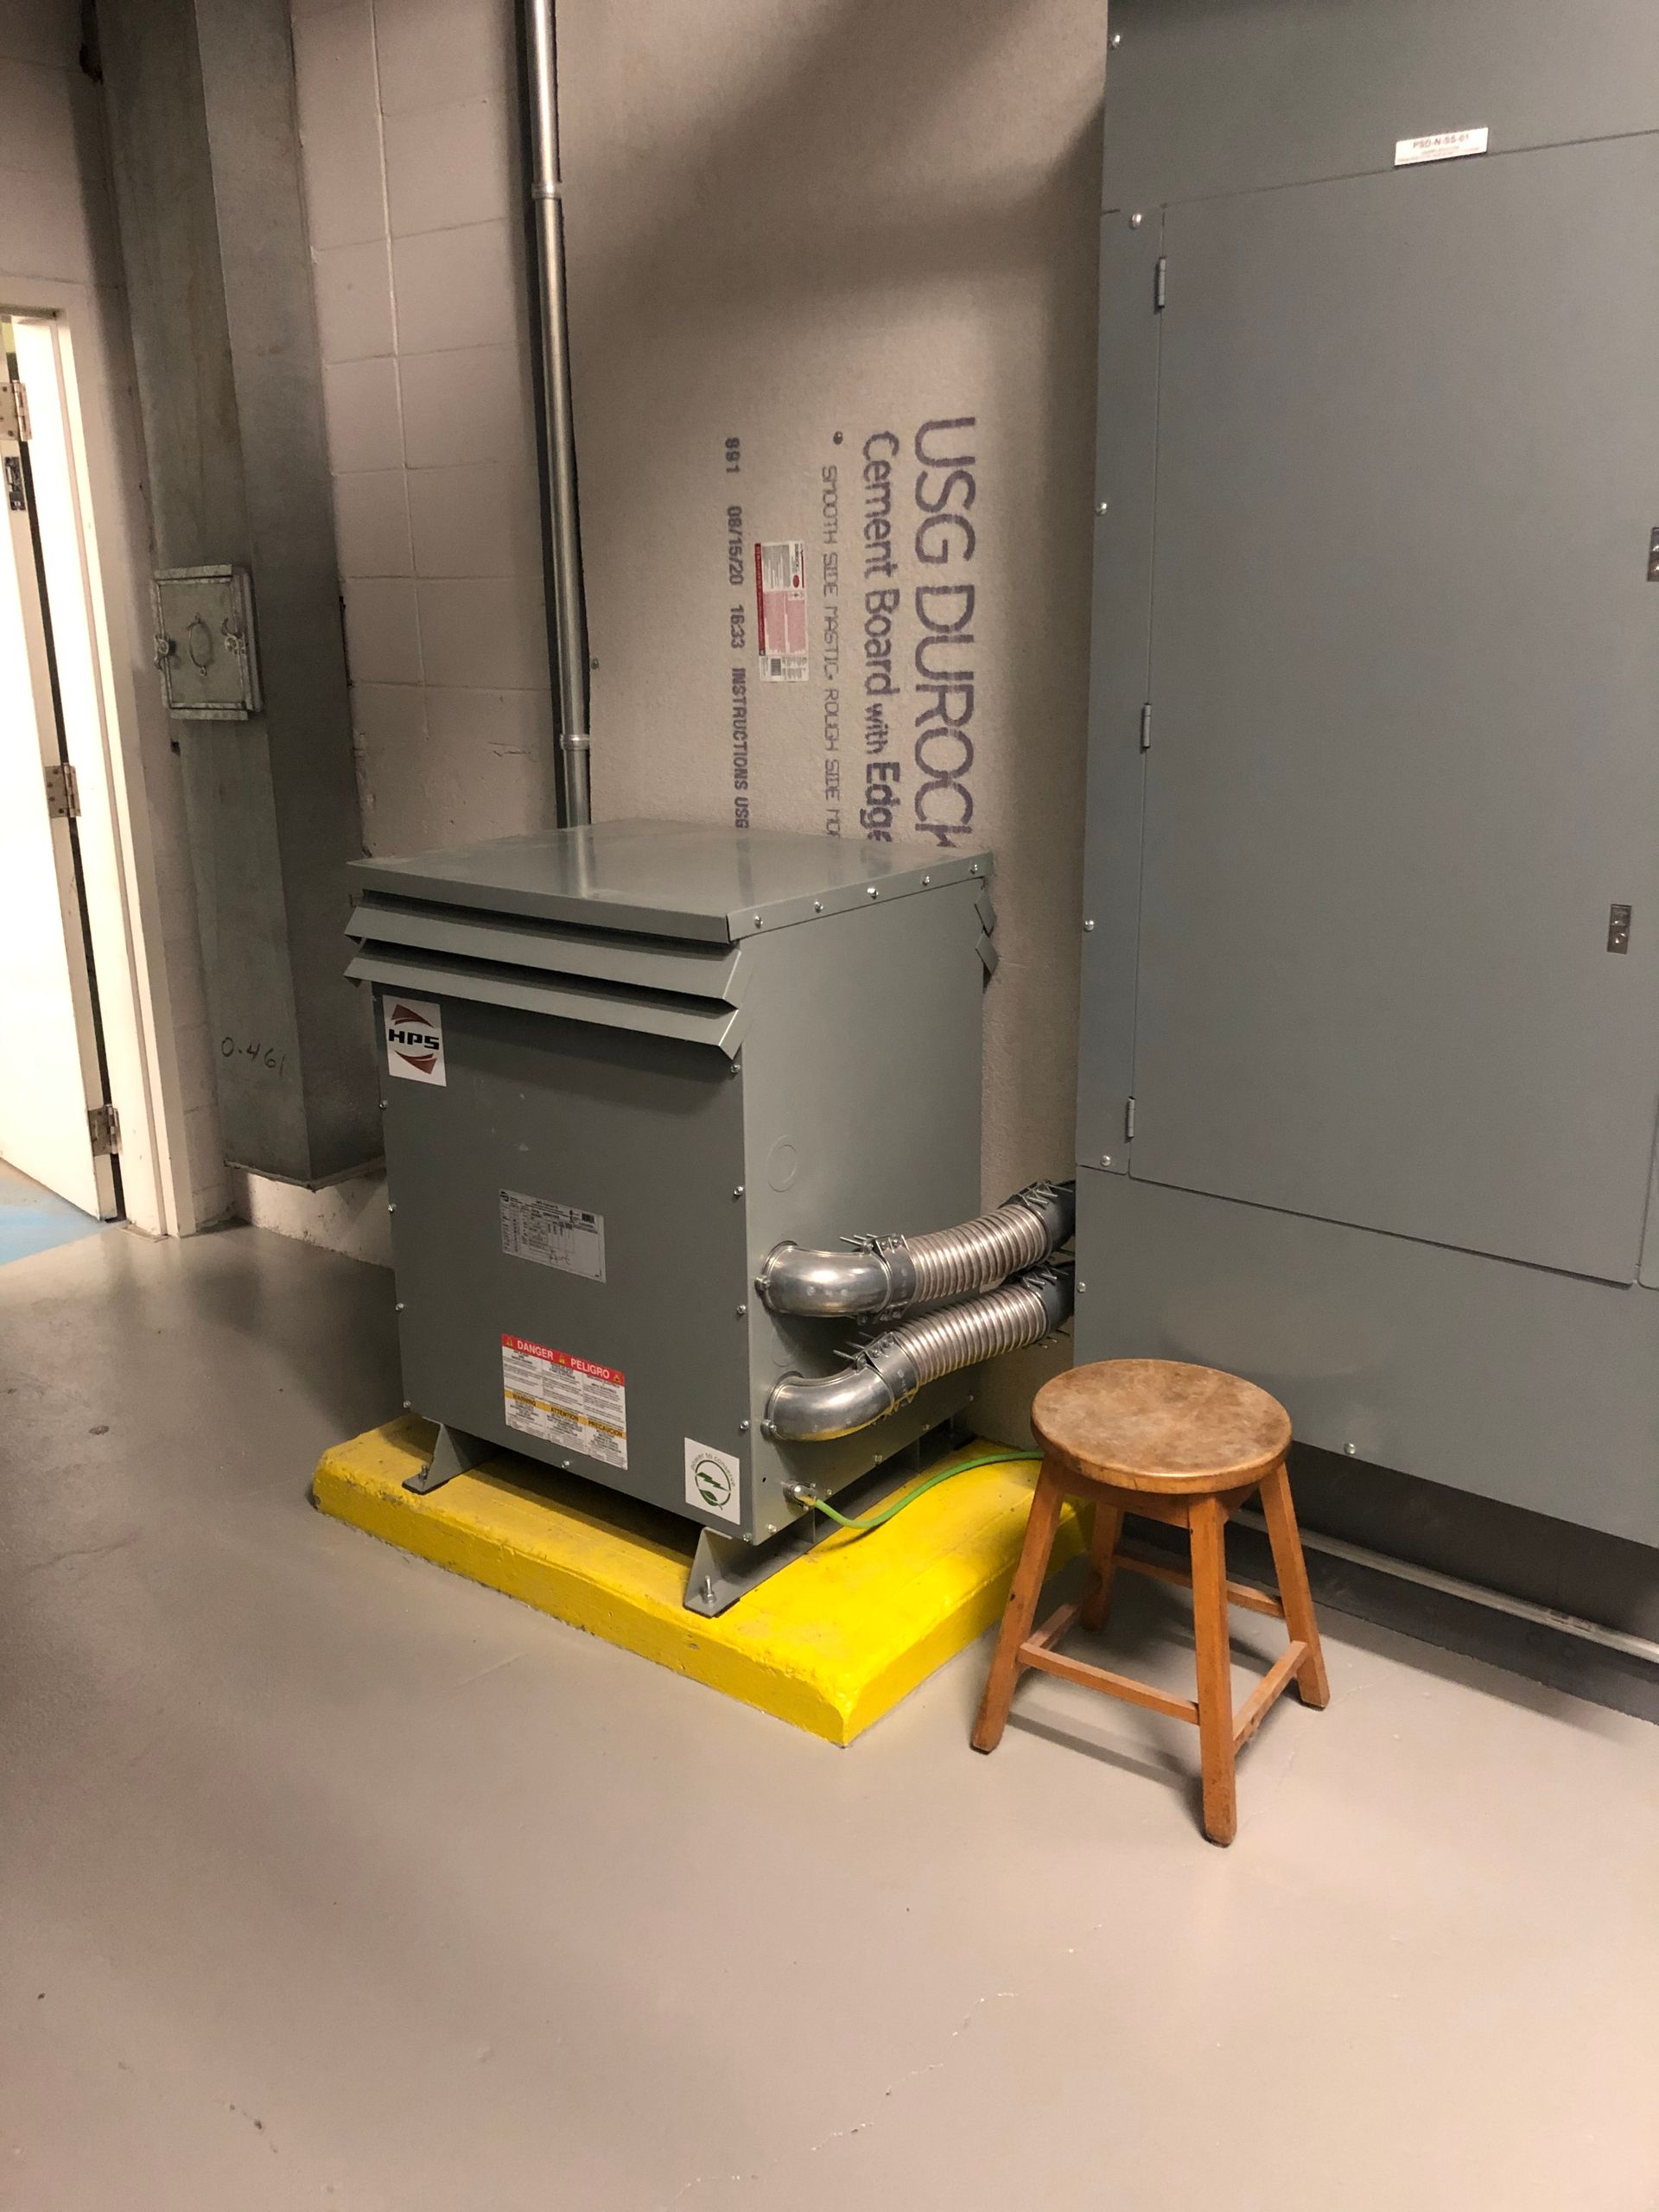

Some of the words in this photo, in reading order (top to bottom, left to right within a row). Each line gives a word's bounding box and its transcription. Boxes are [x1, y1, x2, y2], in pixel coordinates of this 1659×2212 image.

[822, 464, 838, 545] SMOOTH
[863, 431, 899, 579] Cement
[914, 416, 976, 563] USG
[823, 551, 838, 597] SIDE
[864, 588, 900, 696] Board
[732, 668, 748, 791] INSTRUCTIONS
[824, 689, 839, 752] ROUGH
[864, 703, 889, 754] with
[825, 759, 840, 802] SIDE
[734, 797, 749, 829] USG
[388, 1028, 440, 1051] HPS
[517, 1340, 554, 1360] DANGER
[570, 1357, 610, 1379] PELIGRO
[550, 1407, 579, 1421] ATTENTION
